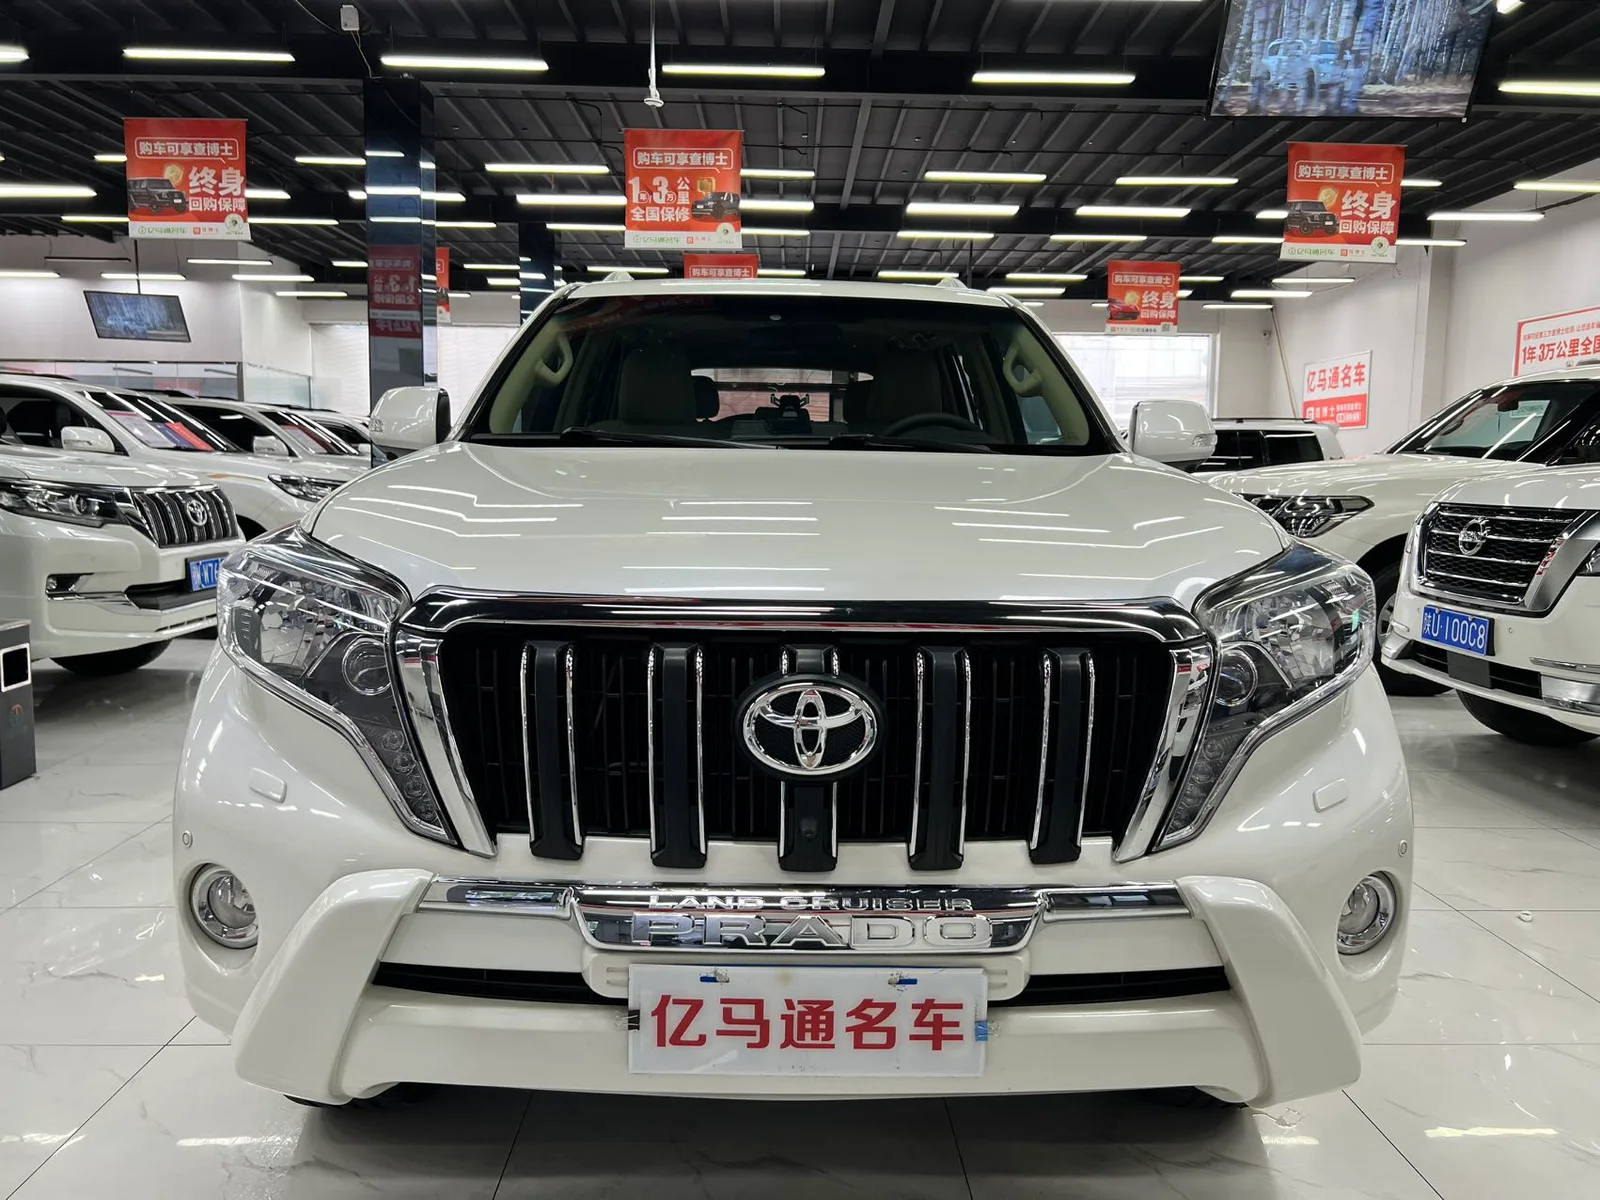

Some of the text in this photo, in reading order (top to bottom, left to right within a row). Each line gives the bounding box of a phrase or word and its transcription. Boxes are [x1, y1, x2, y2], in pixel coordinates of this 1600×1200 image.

[139, 141, 234, 156] 购车可享查博士
[637, 151, 728, 166] 购车可享查博士
[1298, 165, 1388, 180] 购车可享查博士
[188, 166, 244, 196] 终身
[188, 197, 246, 212] 回购保障
[1340, 189, 1397, 219] 终身
[630, 206, 690, 222] 全国保修
[1338, 219, 1395, 235] 回购保障
[1141, 290, 1177, 309] 终身
[1307, 361, 1366, 393] 亿马通名车
[648, 895, 974, 911] LAND CRUISER
[630, 912, 993, 949] PRADO
[650, 993, 966, 1052] 亿马通名车
